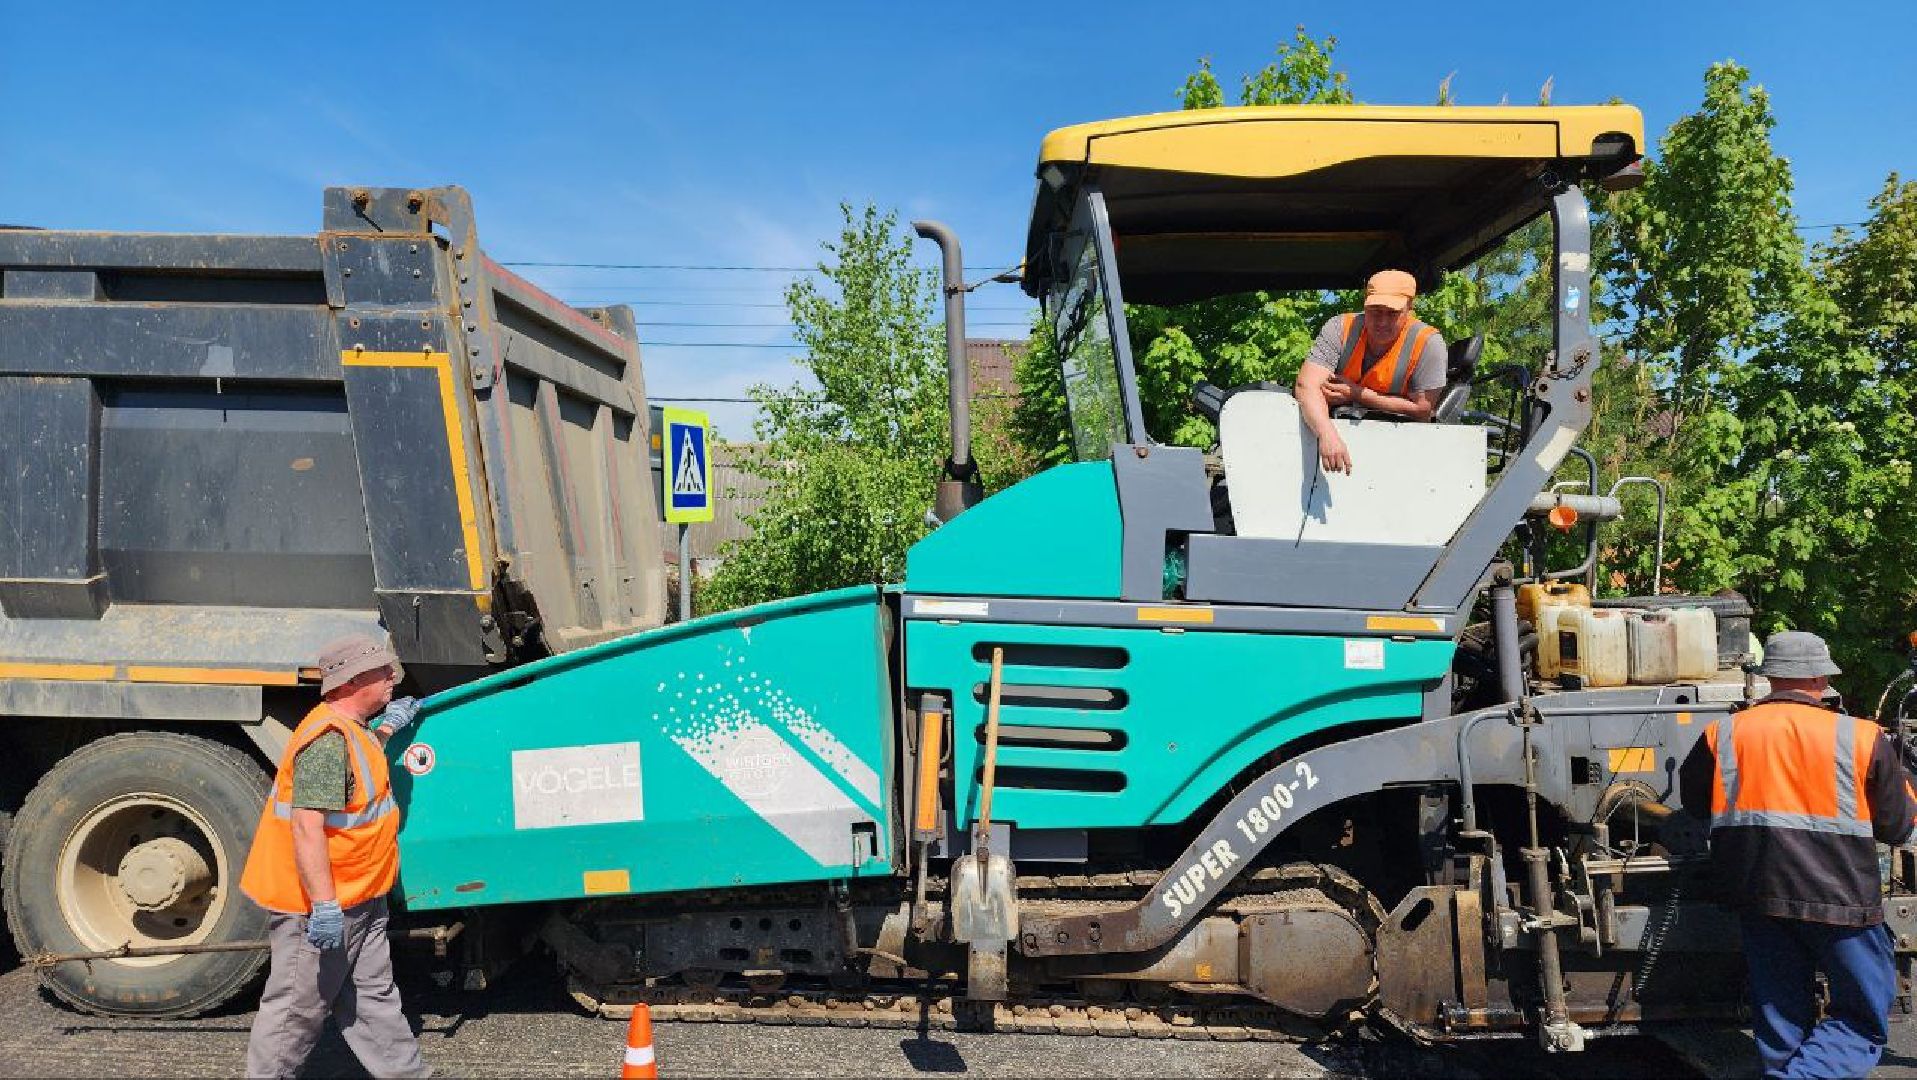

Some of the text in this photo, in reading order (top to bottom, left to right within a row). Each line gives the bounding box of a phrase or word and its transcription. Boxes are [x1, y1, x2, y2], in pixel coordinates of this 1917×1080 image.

[516, 765, 640, 793] VÖGELE
[1163, 761, 1319, 918] SUPER 1800-2
